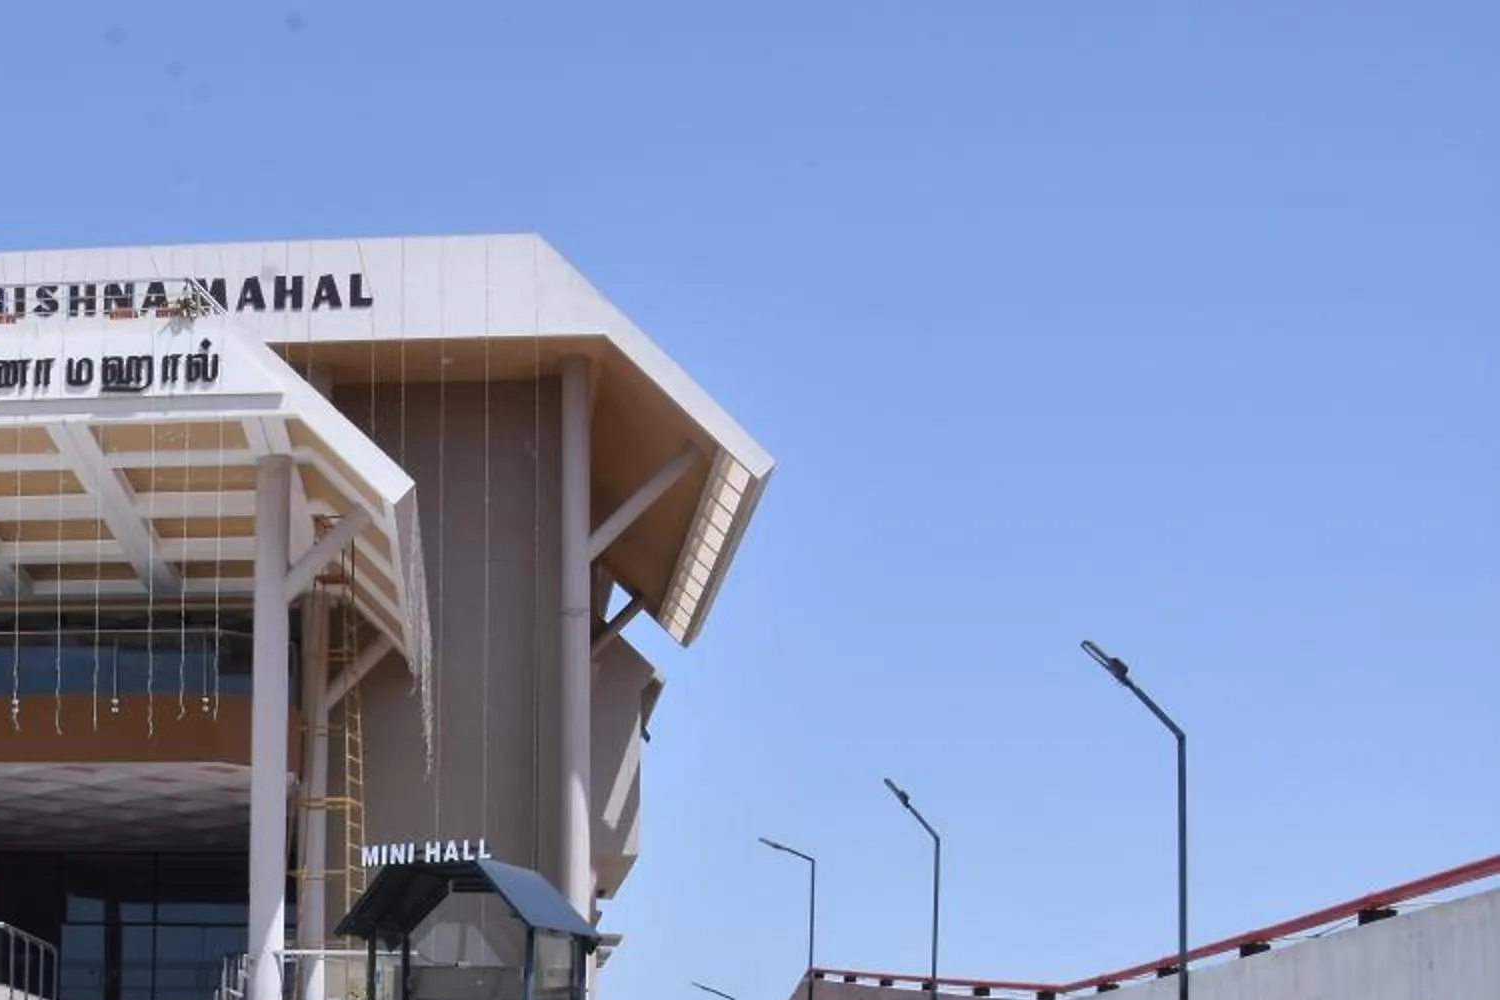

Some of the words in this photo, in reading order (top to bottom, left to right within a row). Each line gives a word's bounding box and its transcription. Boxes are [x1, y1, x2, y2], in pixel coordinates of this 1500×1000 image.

[66, 338, 219, 392] மஹால்
[361, 842, 415, 867] MINI
[425, 838, 491, 863] HALL
